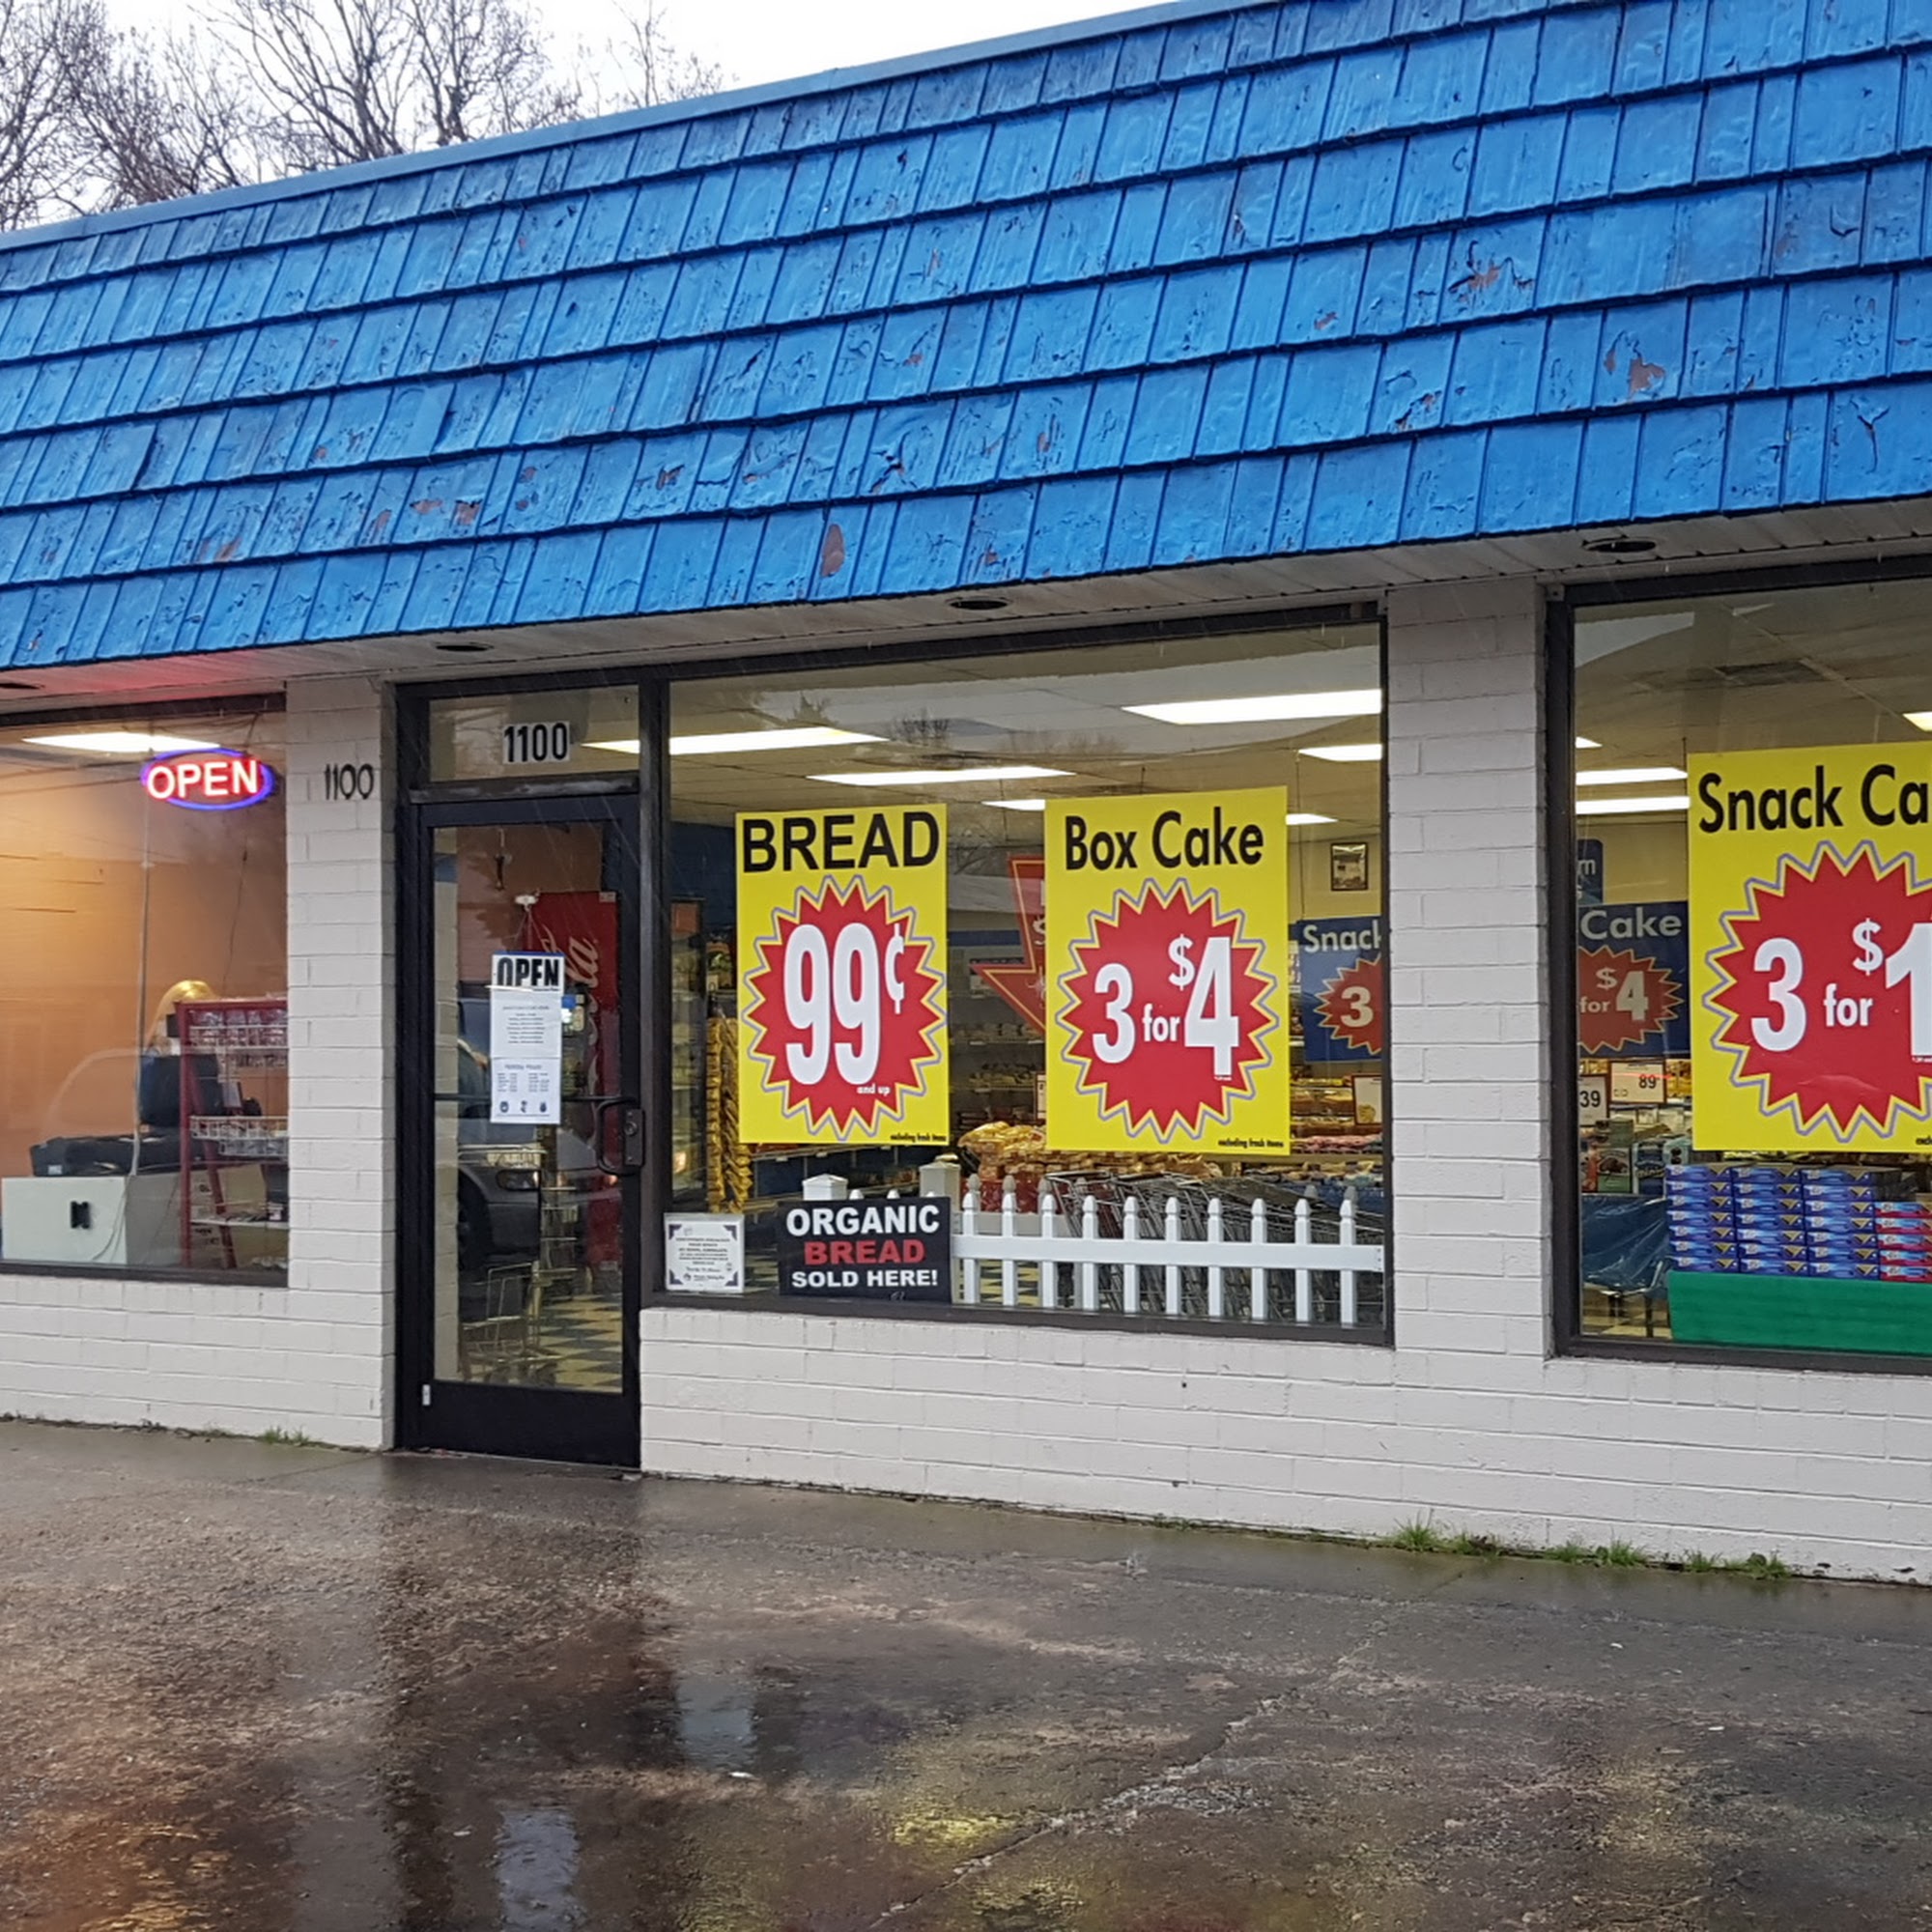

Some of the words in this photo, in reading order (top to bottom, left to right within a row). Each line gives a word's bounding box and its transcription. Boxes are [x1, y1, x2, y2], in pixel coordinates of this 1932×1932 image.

[503, 723, 567, 762] 1100
[146, 758, 259, 800] OPEN
[324, 763, 374, 800] 1100
[1698, 765, 1844, 834] Snack
[743, 811, 940, 872] BREAD
[1065, 815, 1138, 870] Box
[1152, 806, 1264, 868] Cake
[1580, 906, 1682, 940] Cake
[497, 956, 559, 987] OPEN
[1093, 963, 1135, 1064] 3
[1142, 1003, 1180, 1042] for
[1340, 985, 1374, 1028] 3
[1579, 996, 1610, 1013] for
[1751, 936, 1806, 1052] 3
[1823, 982, 1873, 1027] for
[856, 1083, 876, 1094] and
[877, 1086, 891, 1096] up
[786, 1205, 940, 1236] ORGANIC
[804, 1238, 926, 1265] BREAD
[791, 1271, 859, 1288] SOLD
[867, 1269, 938, 1288] HERE!
